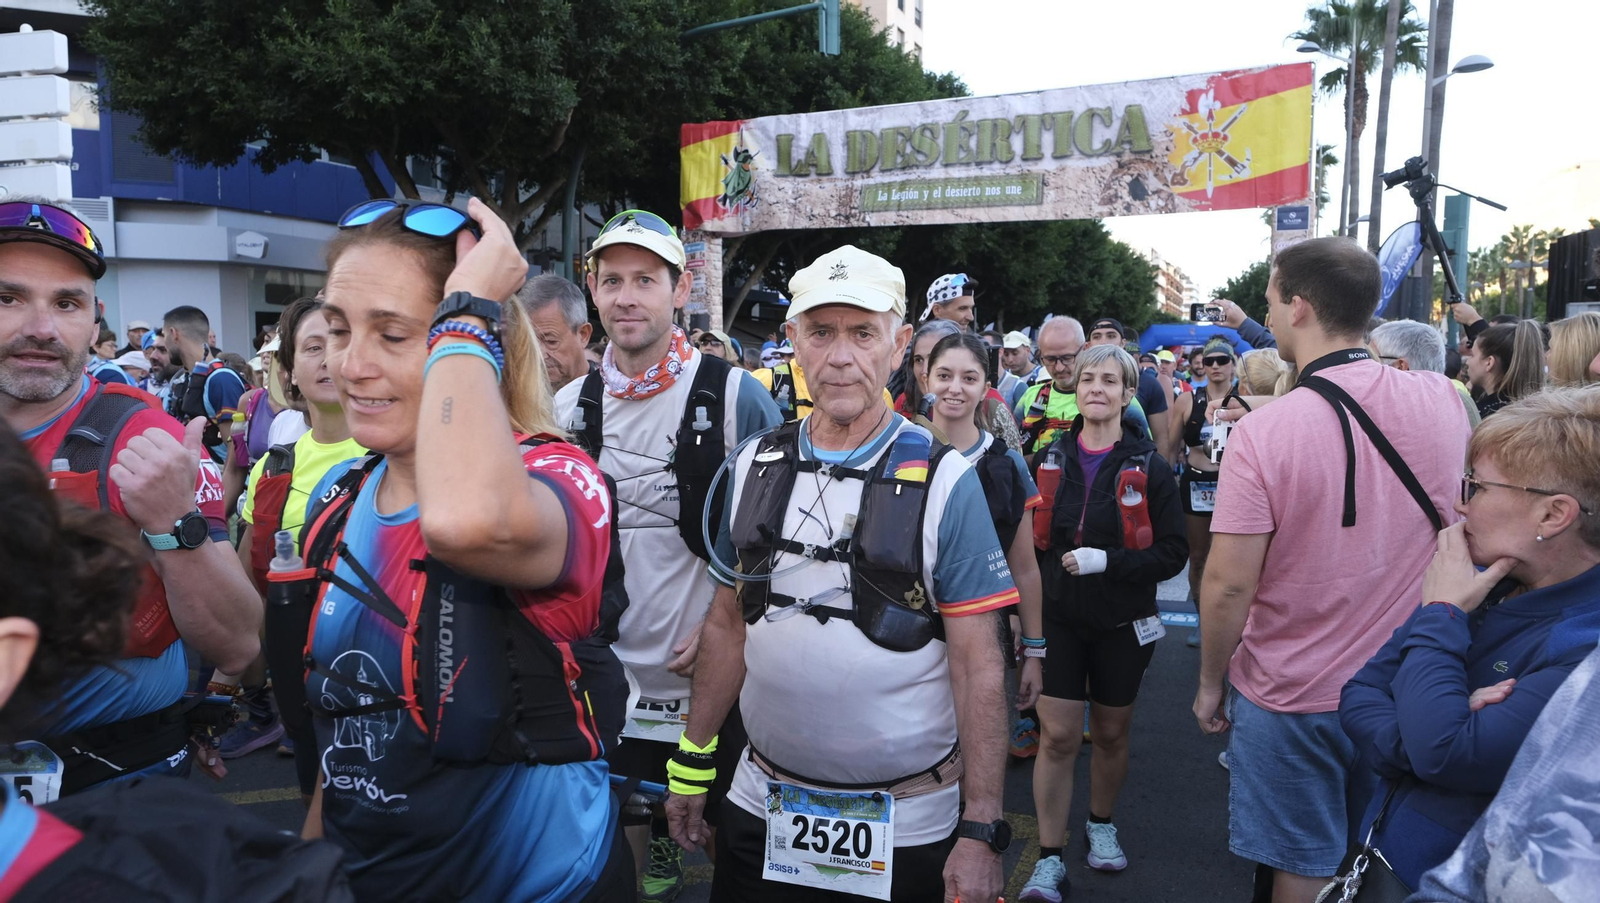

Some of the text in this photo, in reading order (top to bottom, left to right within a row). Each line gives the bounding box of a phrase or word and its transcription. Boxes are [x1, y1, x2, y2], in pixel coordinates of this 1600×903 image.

[774, 103, 1153, 177] LA DESÉRTICA
[877, 184, 1022, 202] La Legión y el desierto nos une
[1348, 352, 1369, 360] SONY
[1201, 491, 1216, 502] 37
[438, 583, 455, 704] SALOMON
[321, 745, 408, 804] Serón
[330, 761, 368, 776] Turismo
[783, 788, 800, 804] LA
[791, 814, 872, 860] 2520
[768, 862, 793, 874] asisa
[828, 857, 871, 869] J.FRANCISCO
